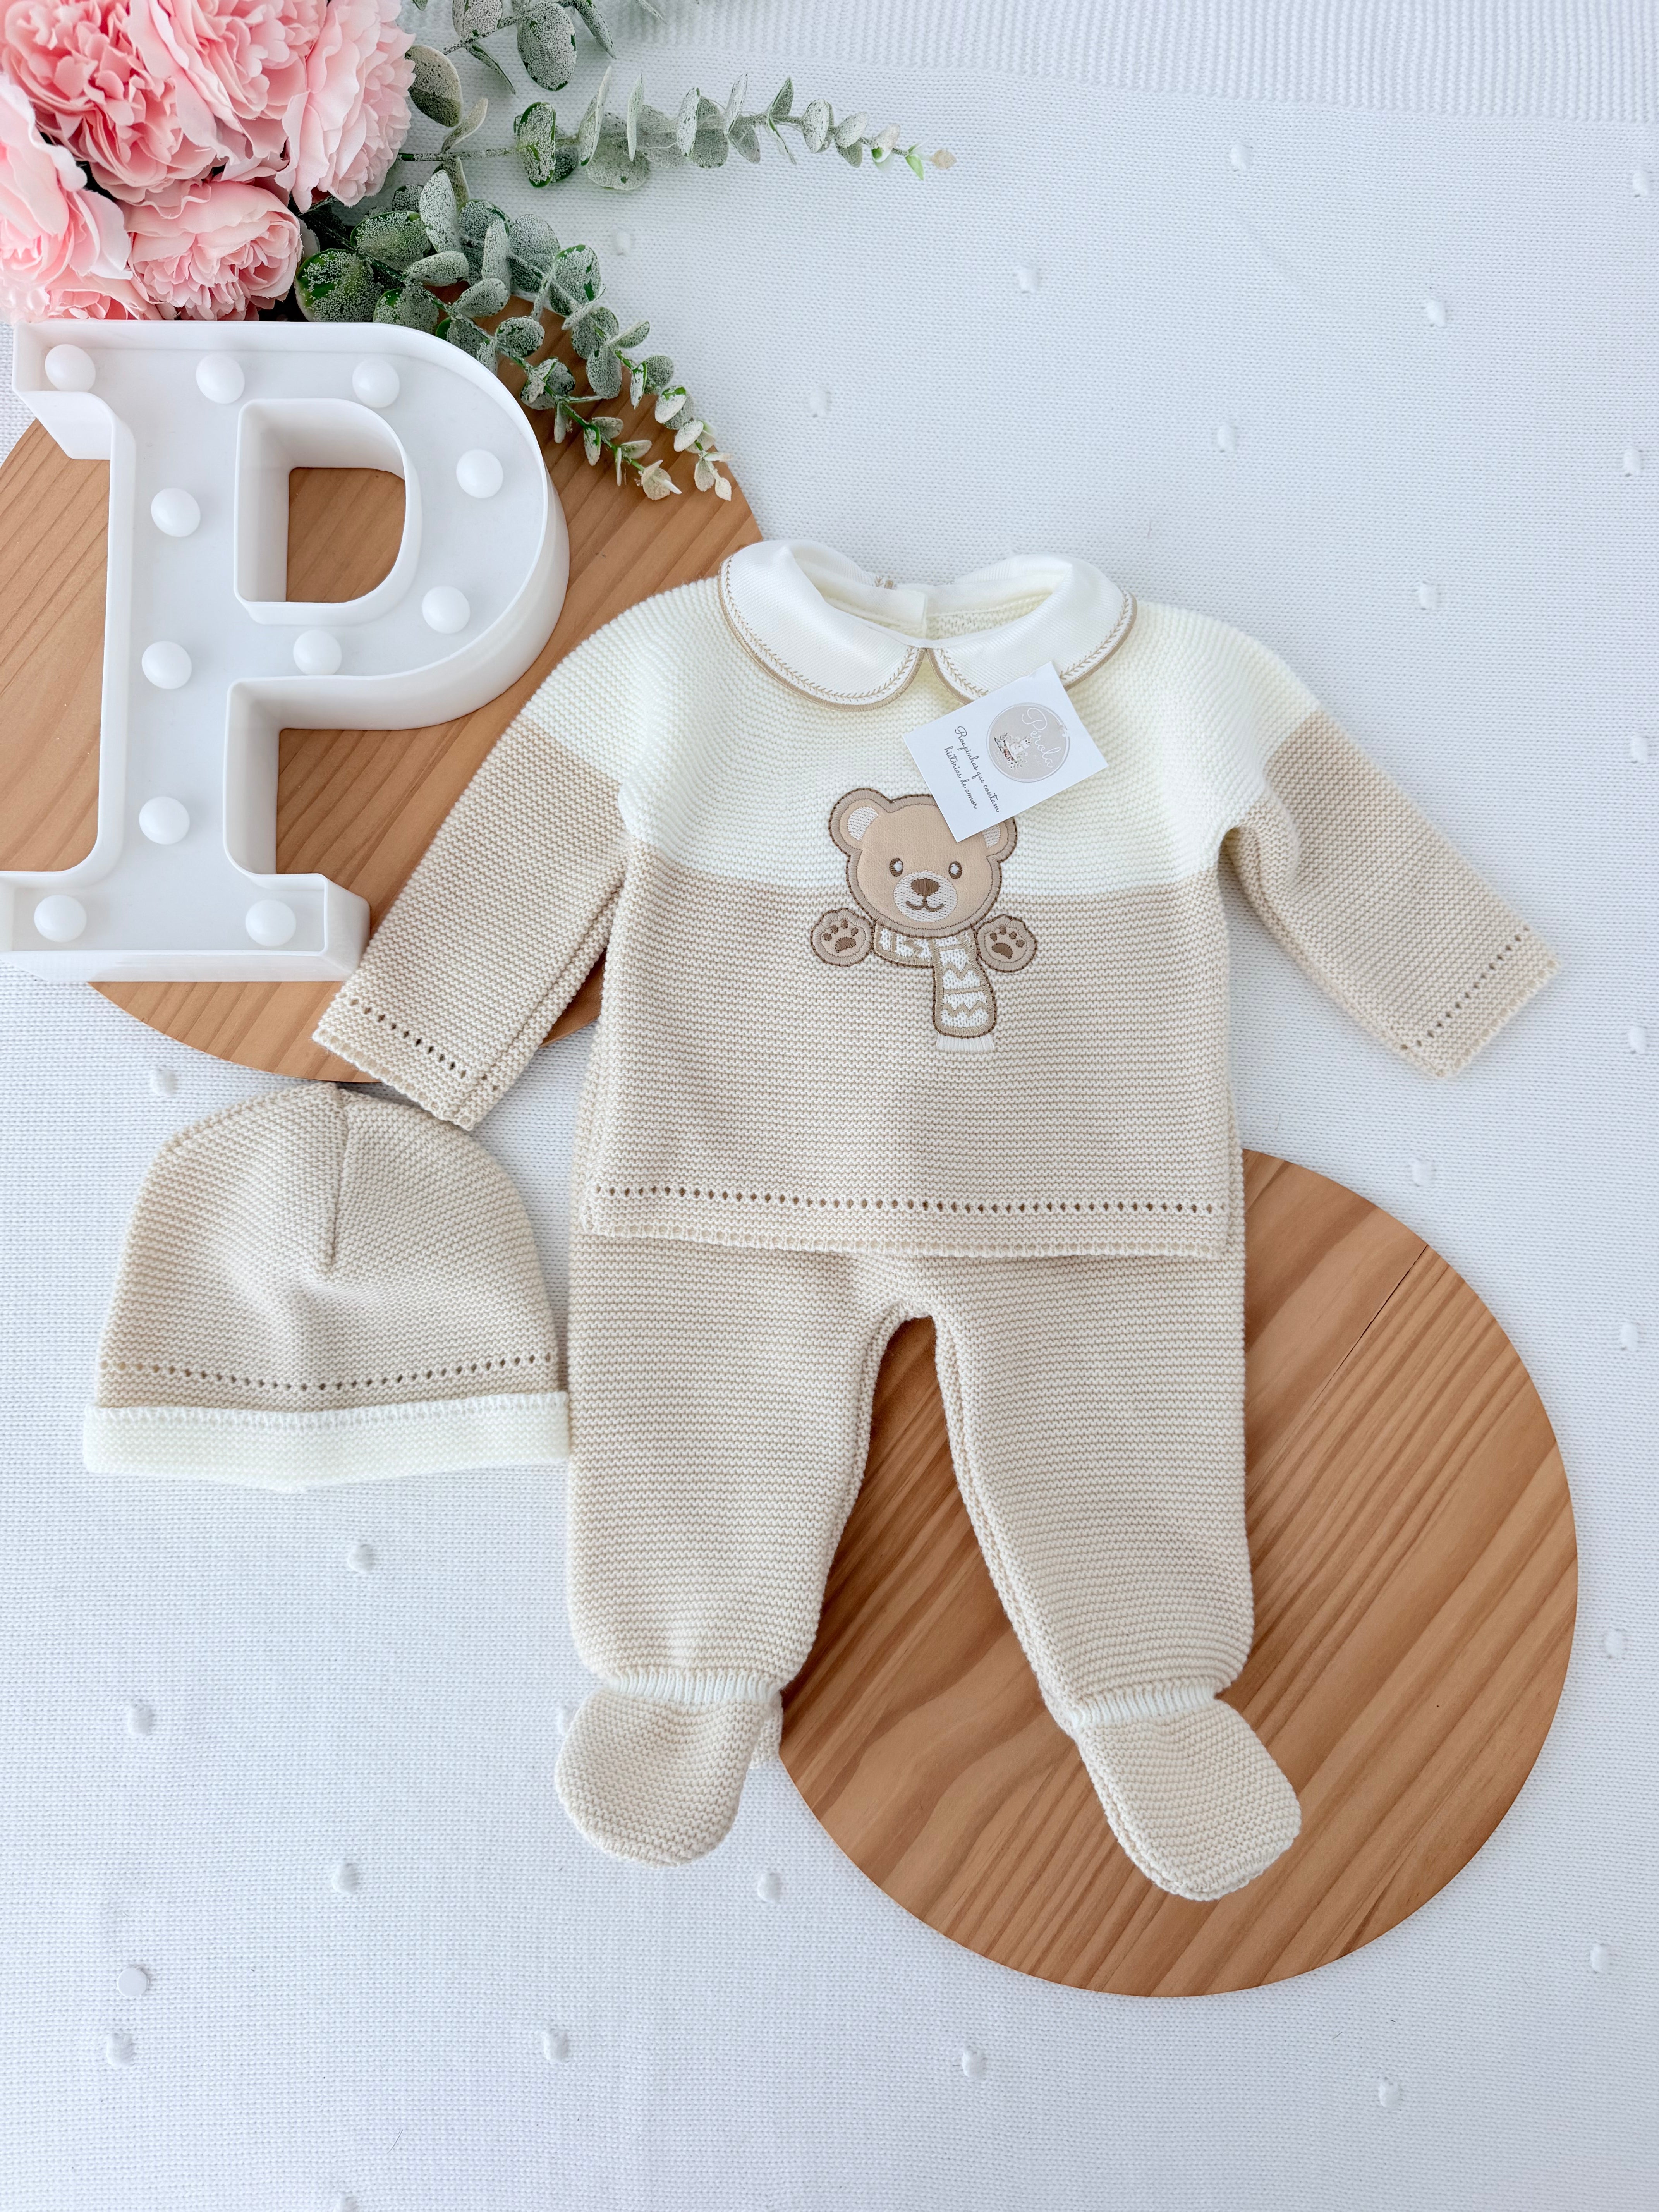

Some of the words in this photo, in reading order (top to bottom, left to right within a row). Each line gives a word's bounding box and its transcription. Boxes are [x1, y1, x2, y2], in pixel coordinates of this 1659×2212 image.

[0, 321, 569, 982] P
[955, 726, 979, 771] Roupinhas
[971, 772, 984, 784] que
[983, 785, 999, 812] contam
[1022, 708, 1061, 768] Pérola
[944, 746, 962, 778] histórias
[960, 779, 970, 788] de
[965, 789, 977, 809] amor
